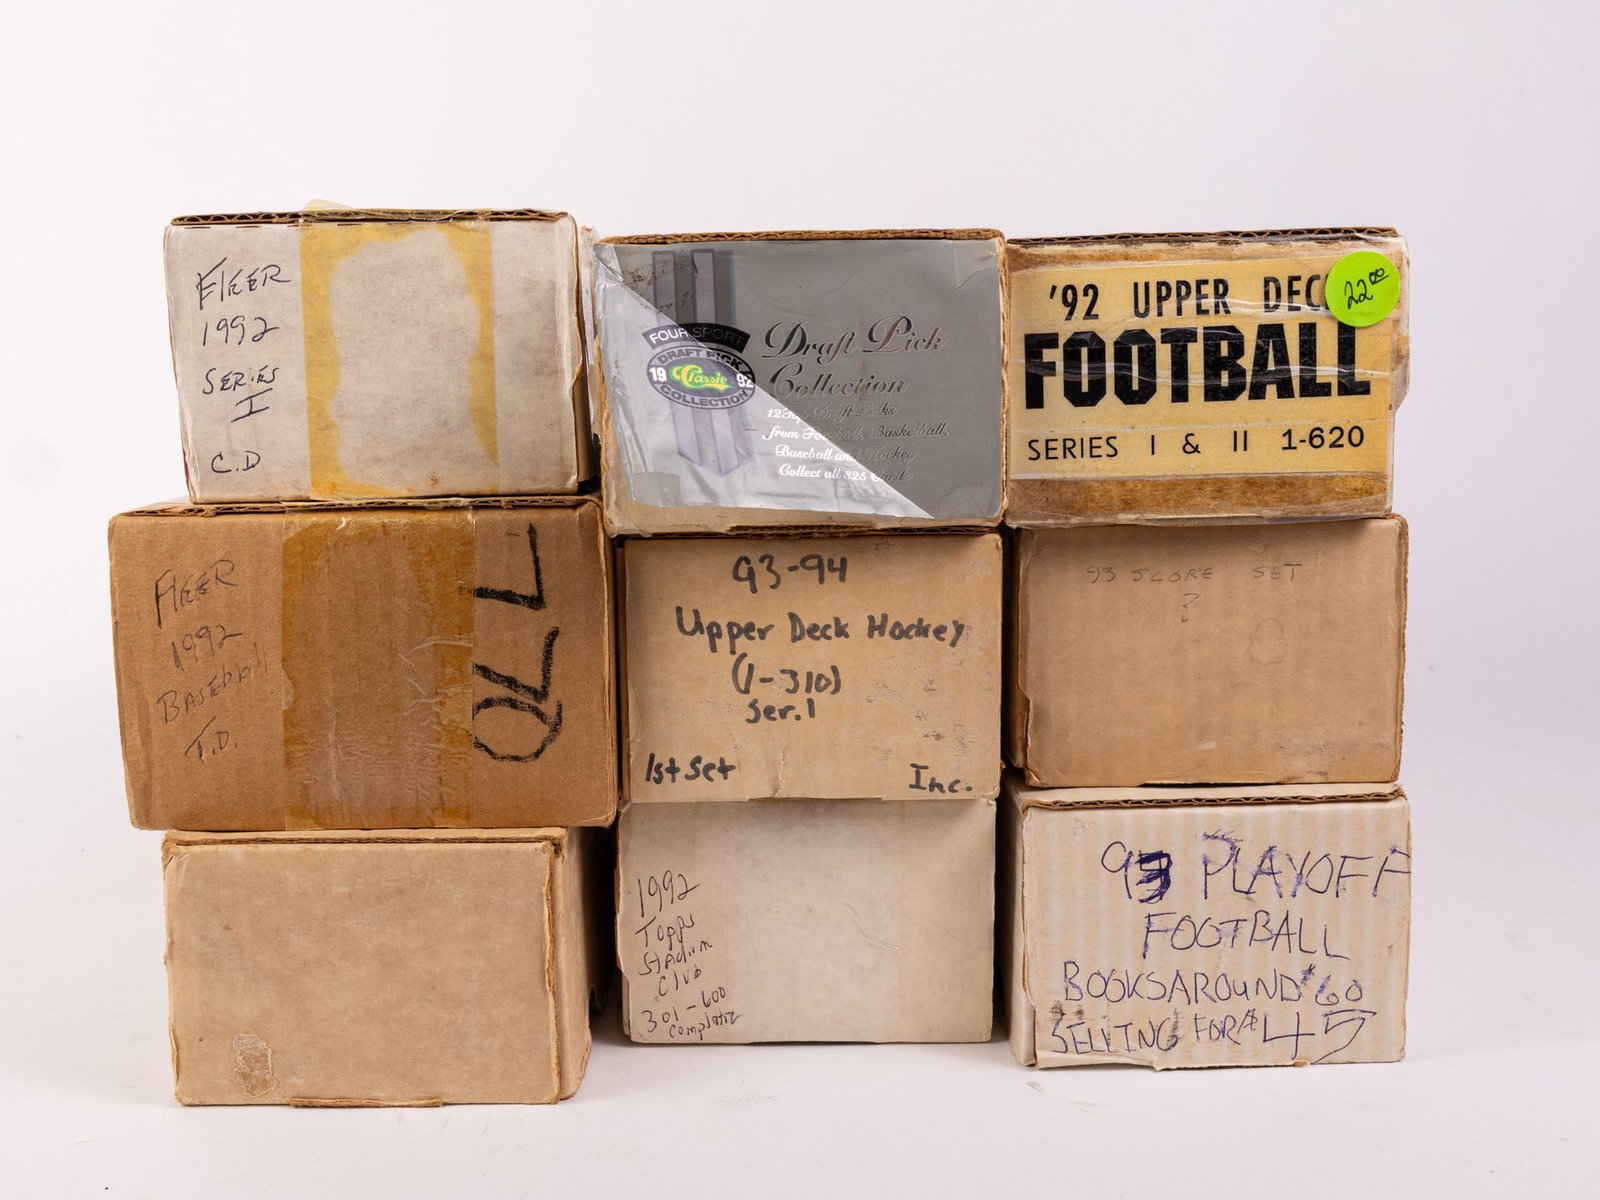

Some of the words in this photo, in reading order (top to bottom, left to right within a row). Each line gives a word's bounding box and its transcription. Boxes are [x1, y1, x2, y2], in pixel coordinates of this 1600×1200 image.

[1049, 284, 1099, 321] '92
[1133, 278, 1232, 319] UPPER
[1263, 273, 1329, 313] DEC
[202, 316, 280, 346] 1992
[649, 328, 689, 345] FOUR
[693, 327, 744, 345] SPORT
[762, 320, 857, 365] Draft
[862, 315, 945, 354] Pick
[657, 348, 702, 365] DRAFT
[706, 350, 743, 370] PICK
[1024, 321, 1371, 410] FOOTBALL
[649, 367, 667, 382] 19
[736, 373, 754, 388] 92
[769, 362, 910, 399] Collection
[660, 385, 749, 407] COLLECTION
[767, 408, 782, 419] 12
[813, 404, 855, 422] Draft
[762, 426, 800, 440] from
[871, 422, 948, 438] Baskeball,
[1028, 436, 1118, 461] SERIES
[1182, 433, 1201, 454] &
[1282, 425, 1365, 450] 1-620
[775, 444, 833, 460] Baseball
[779, 463, 822, 478] Collect
[824, 467, 843, 478] all
[732, 553, 849, 594] 93-94
[1131, 567, 1214, 583] SCORE
[1253, 563, 1302, 582] SET
[675, 606, 775, 655] Upper
[788, 612, 850, 643] Deck
[867, 613, 965, 648] Hockey
[172, 625, 243, 672] 1992
[732, 652, 842, 695] (1-310)
[684, 755, 736, 782] Set
[908, 762, 973, 795] Inc.
[1202, 829, 1411, 900] PLAYOFF
[638, 870, 700, 918] 1992
[635, 914, 695, 951] Topps
[1143, 909, 1350, 960] FOOTBALL
[1195, 1013, 1241, 1045] FOR
